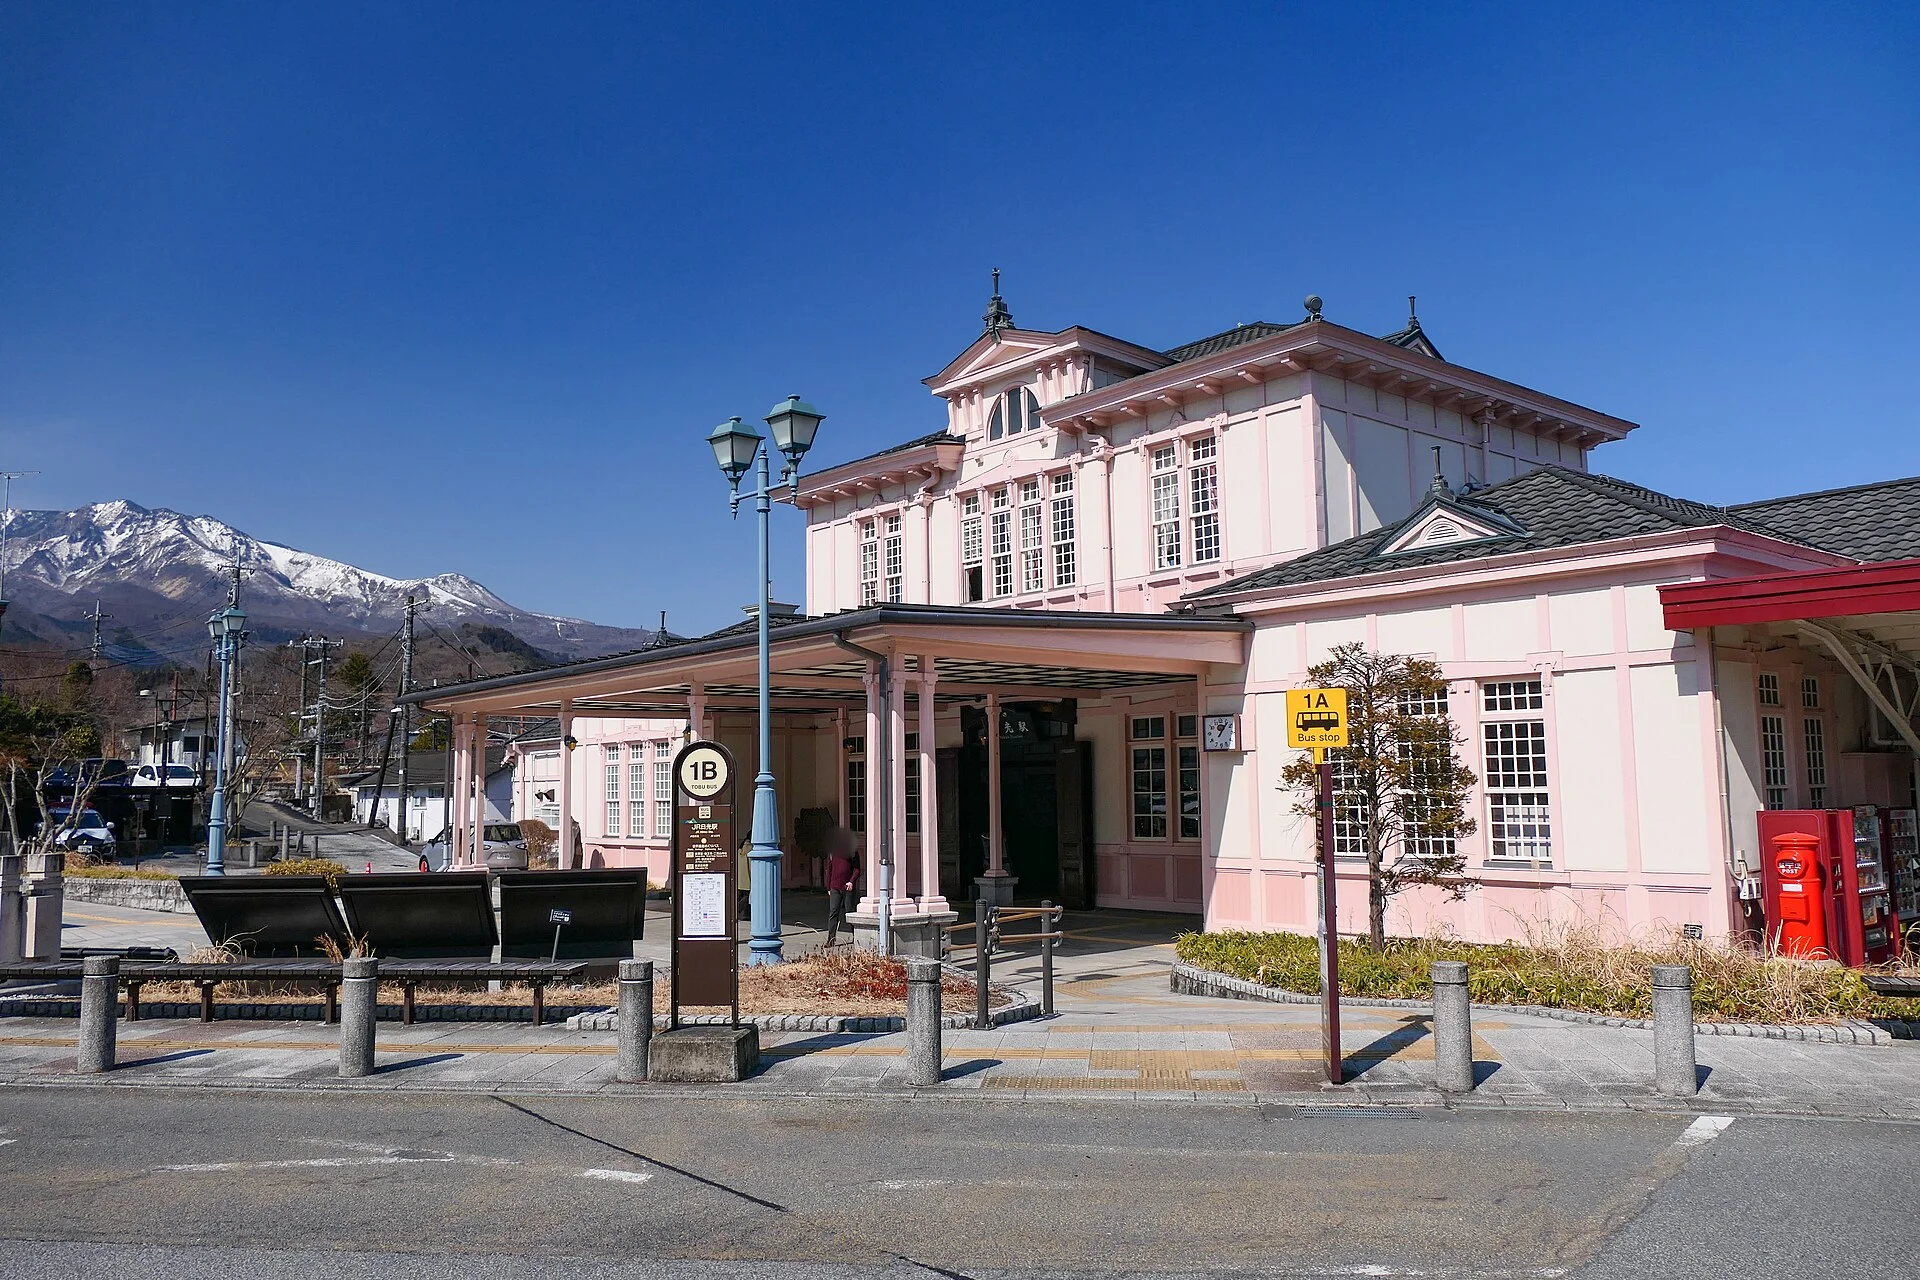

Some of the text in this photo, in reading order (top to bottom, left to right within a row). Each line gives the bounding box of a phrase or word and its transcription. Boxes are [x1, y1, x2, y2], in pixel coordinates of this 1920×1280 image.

[1304, 693, 1329, 708] 1A
[1298, 734, 1340, 743] Bus stop
[690, 761, 718, 781] 1B
